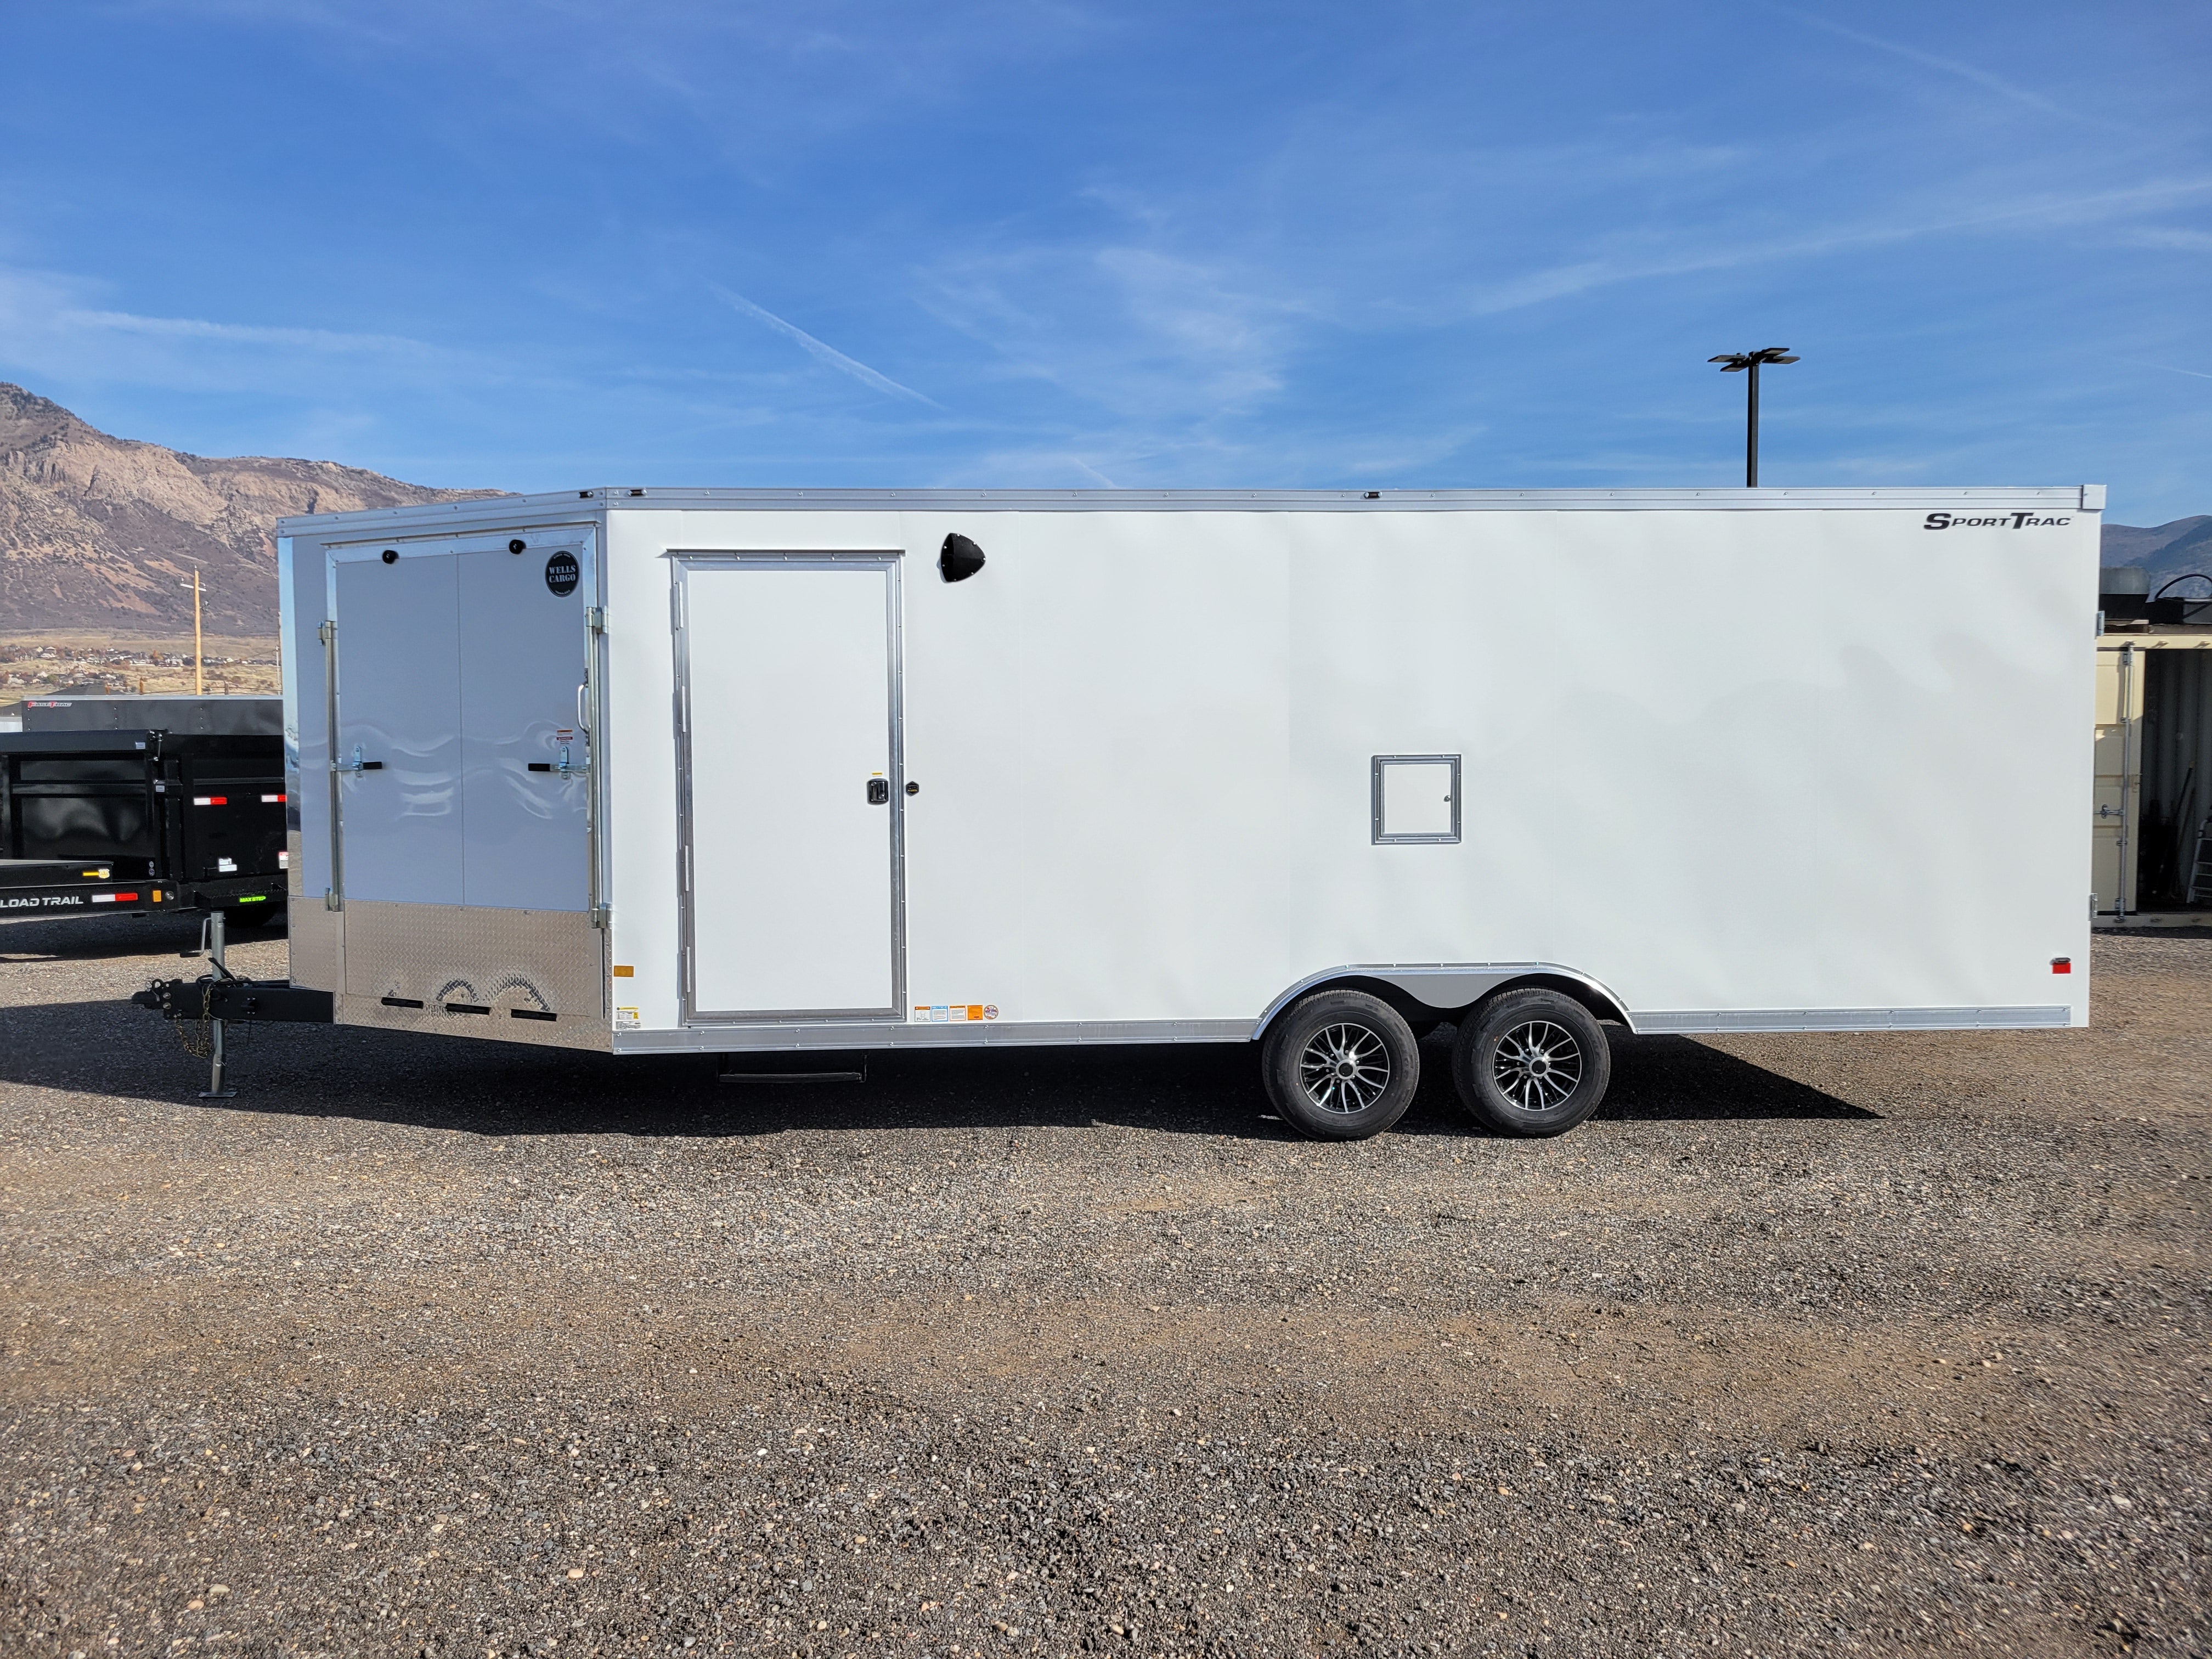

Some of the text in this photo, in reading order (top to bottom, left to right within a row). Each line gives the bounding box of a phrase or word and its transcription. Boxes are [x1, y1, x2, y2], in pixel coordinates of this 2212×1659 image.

[549, 565, 576, 574] WELLS
[549, 574, 576, 583] CARGO
[0, 896, 84, 908] LOAD TRAIL
